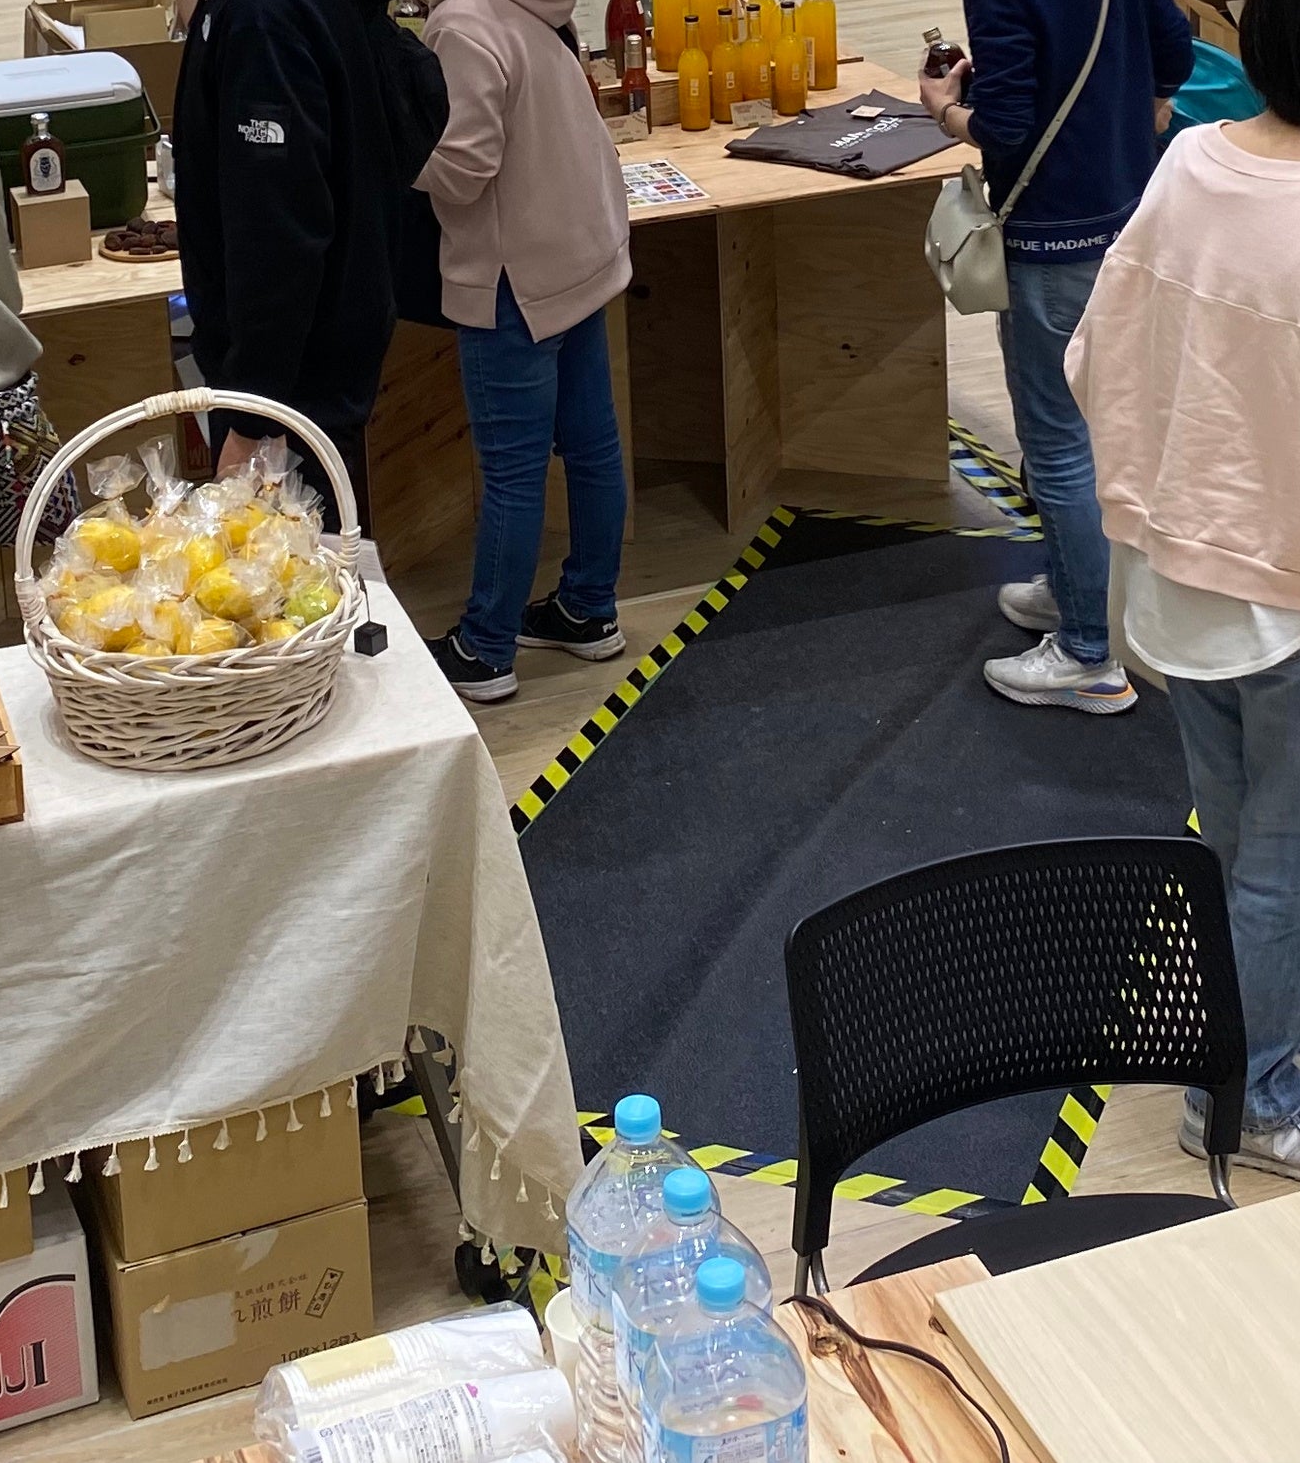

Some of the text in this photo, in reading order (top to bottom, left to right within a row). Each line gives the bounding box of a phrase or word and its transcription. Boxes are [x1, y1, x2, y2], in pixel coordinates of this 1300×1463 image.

[249, 118, 268, 128] THE
[244, 133, 268, 144] FACE
[1044, 233, 1109, 252] MADAME
